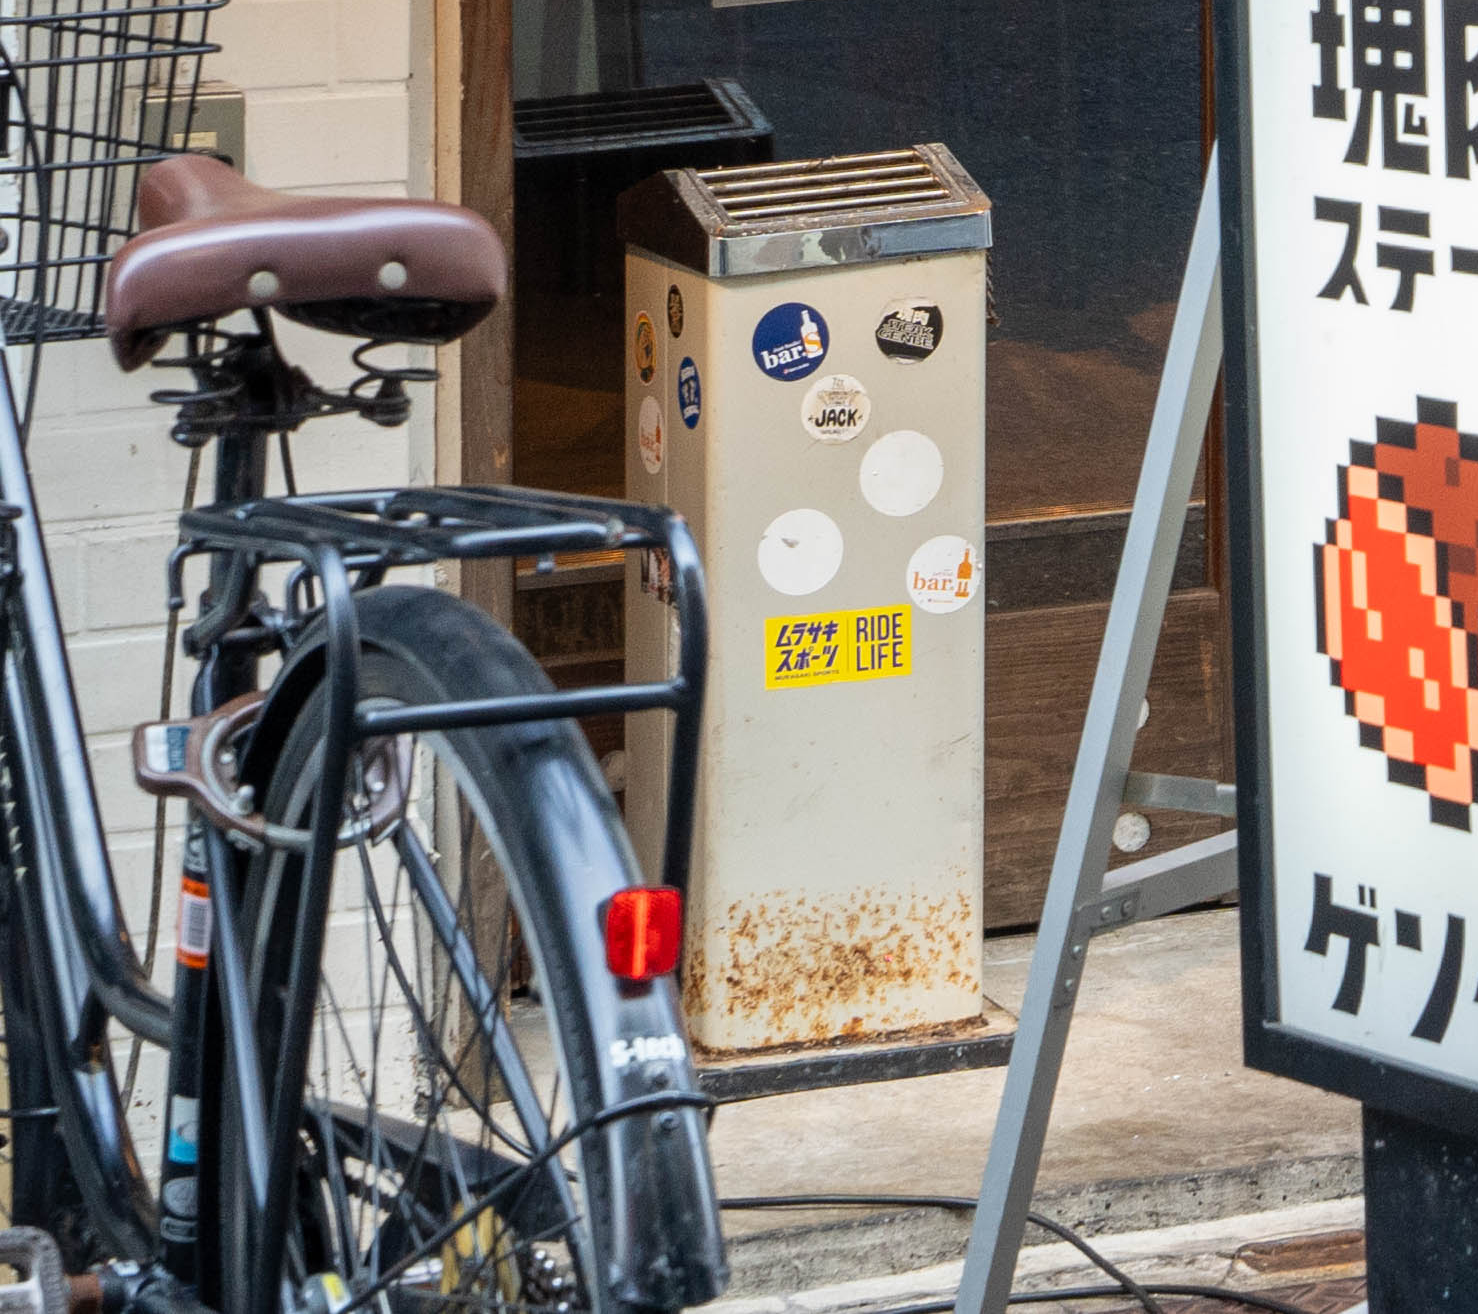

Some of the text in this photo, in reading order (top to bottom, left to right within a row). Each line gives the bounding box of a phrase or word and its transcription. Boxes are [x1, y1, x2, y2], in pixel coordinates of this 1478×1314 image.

[814, 408, 858, 428] JACK
[775, 621, 839, 648] ムラサキ
[856, 612, 903, 643] RIDE
[776, 645, 839, 673] スポーツ
[856, 641, 904, 672] LIFE
